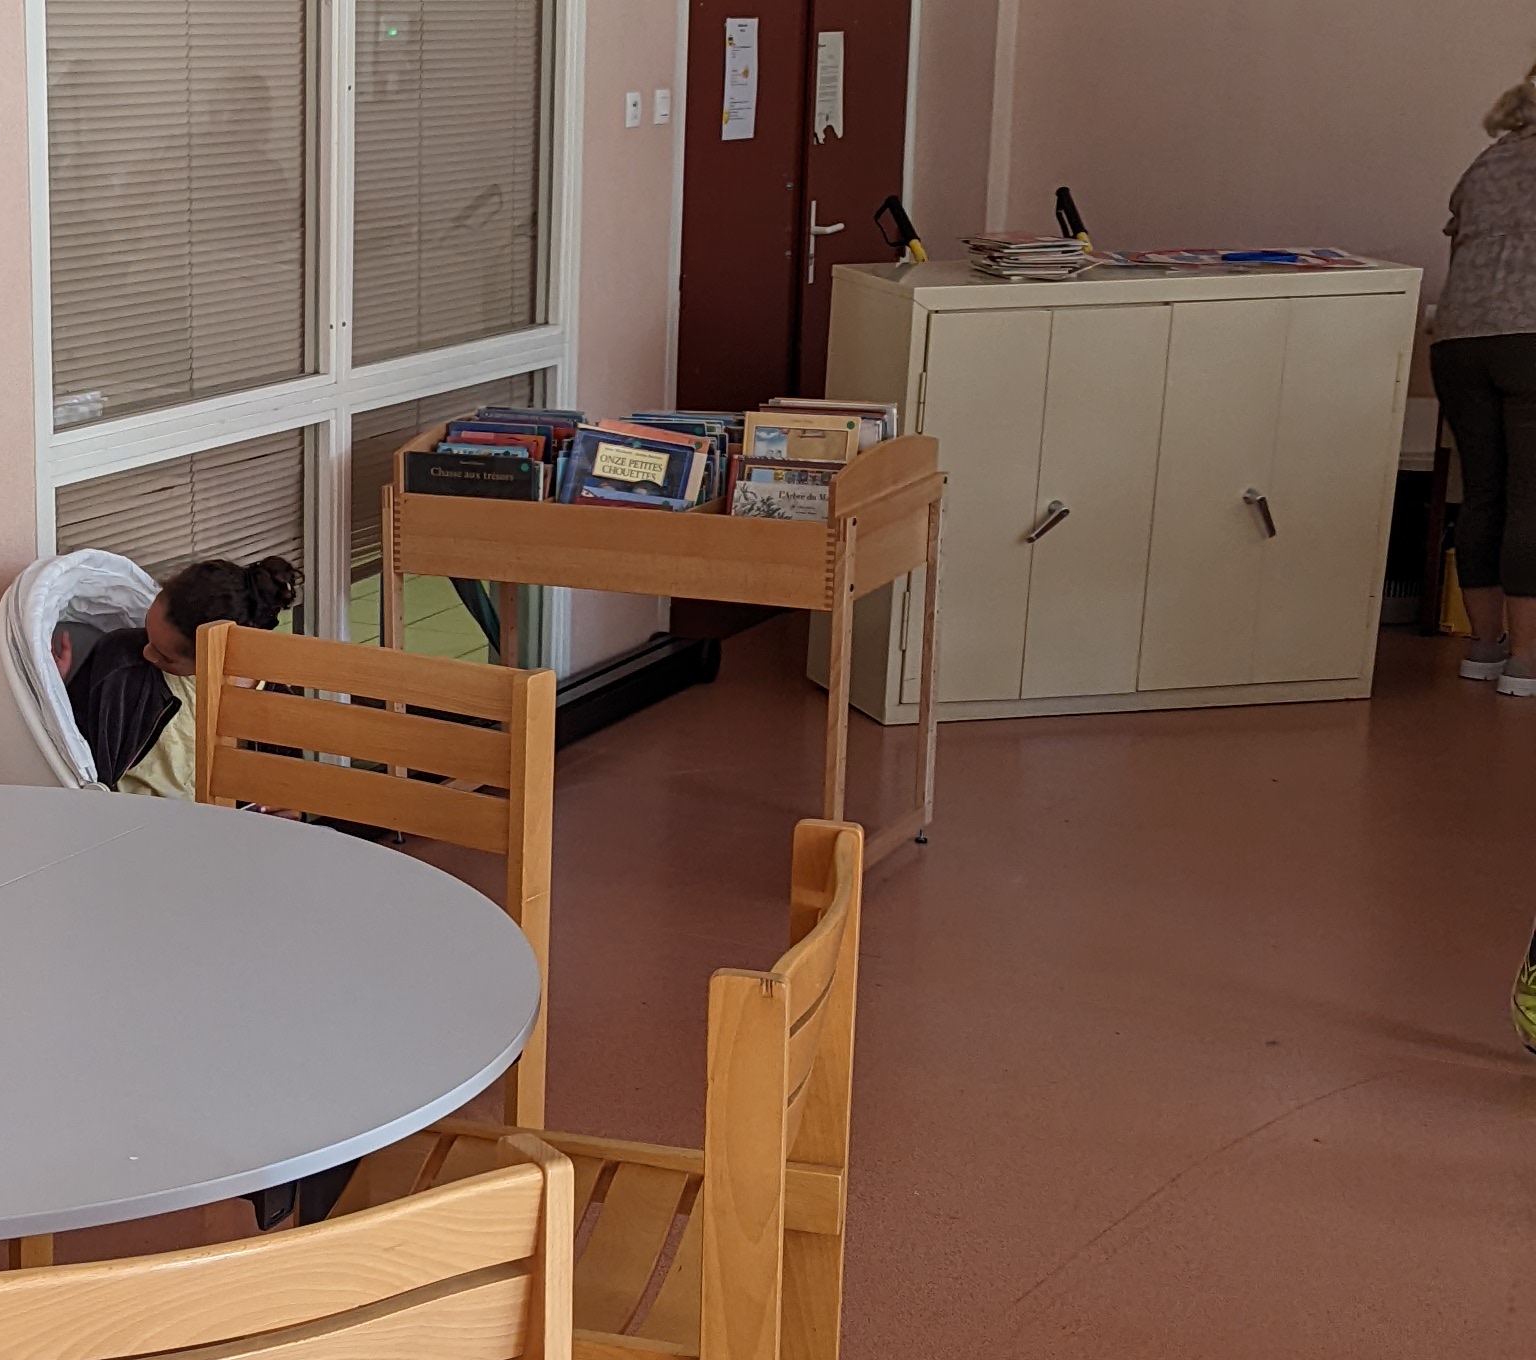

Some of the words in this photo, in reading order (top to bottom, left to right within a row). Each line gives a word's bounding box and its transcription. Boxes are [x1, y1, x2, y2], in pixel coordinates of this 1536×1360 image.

[600, 454, 627, 466] ONZE
[629, 459, 663, 472] PETITES
[430, 467, 462, 478] Chasse
[464, 471, 481, 480] aux
[483, 470, 514, 481] trésors
[602, 465, 657, 481] CHOUETTES
[807, 492, 817, 501] du
